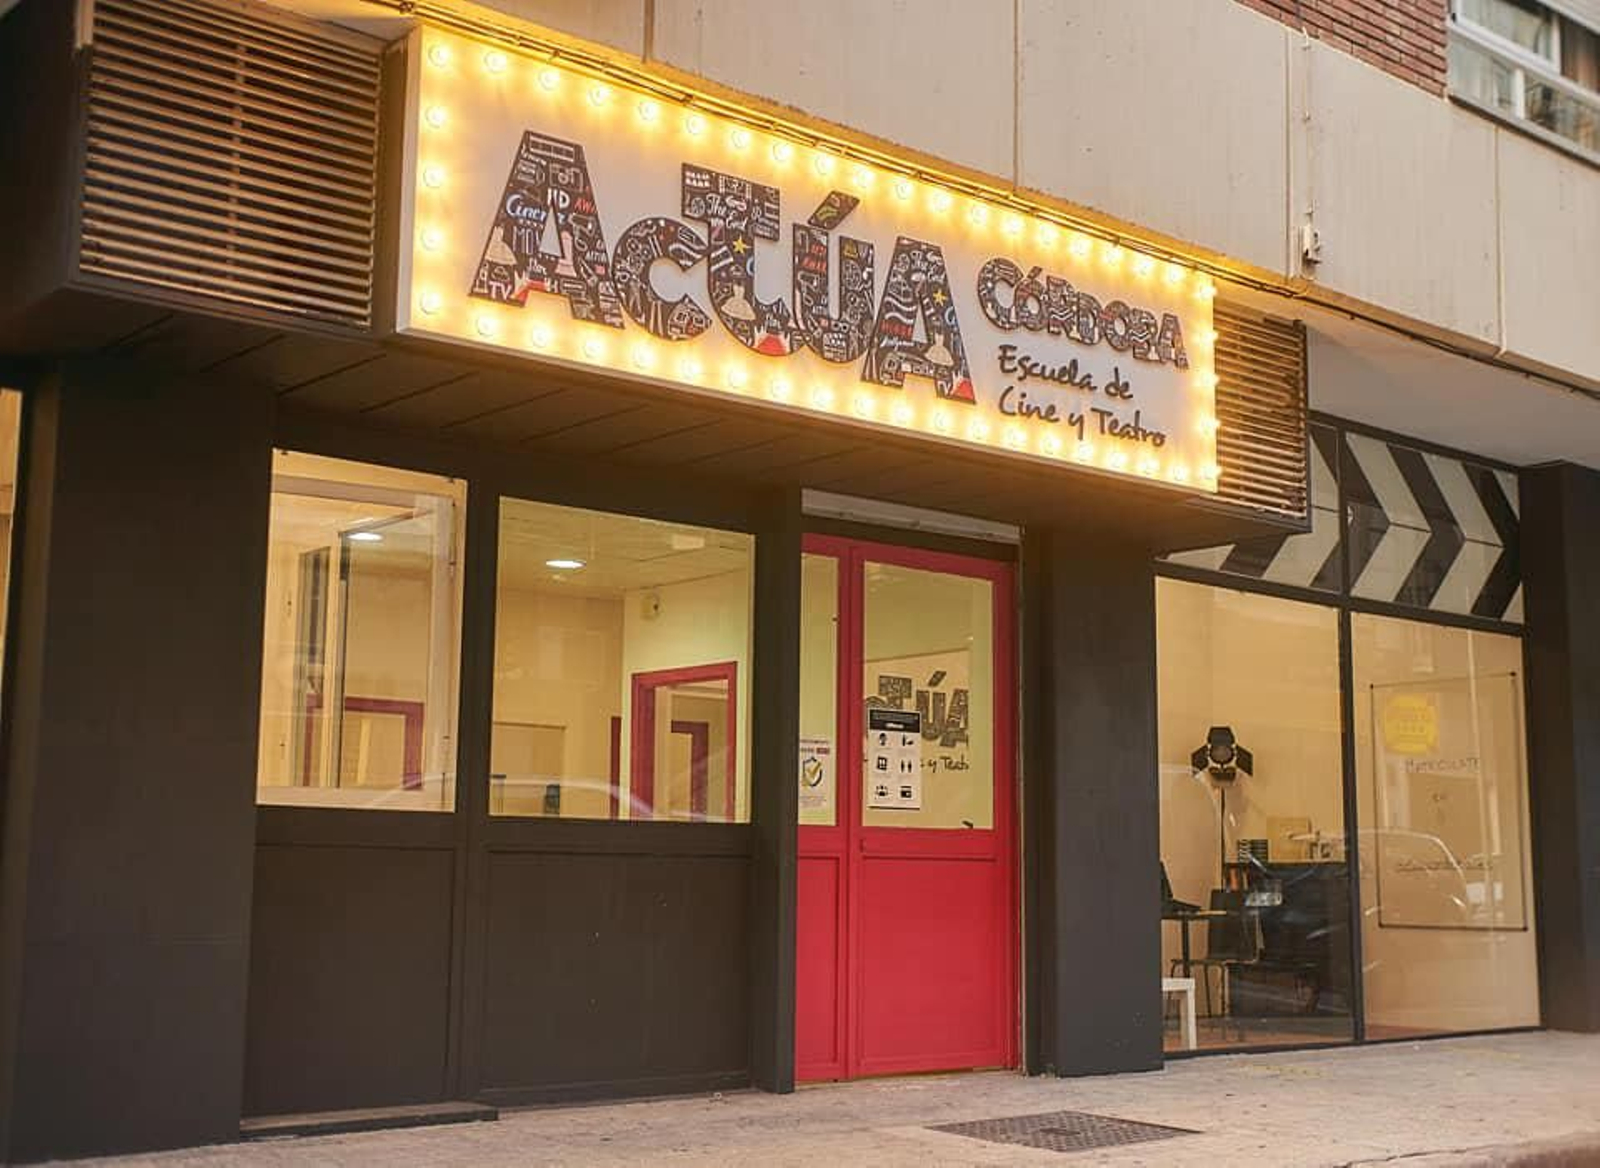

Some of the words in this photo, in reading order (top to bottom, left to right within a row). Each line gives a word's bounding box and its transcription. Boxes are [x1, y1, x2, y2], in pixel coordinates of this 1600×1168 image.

[467, 130, 977, 405] ACTÚA
[977, 257, 1189, 369] CÓRDOBA
[998, 344, 1097, 392] Escuela
[1105, 366, 1133, 399] de
[998, 385, 1060, 423] Cine
[1067, 410, 1085, 440] y
[1090, 406, 1167, 447] Teatro
